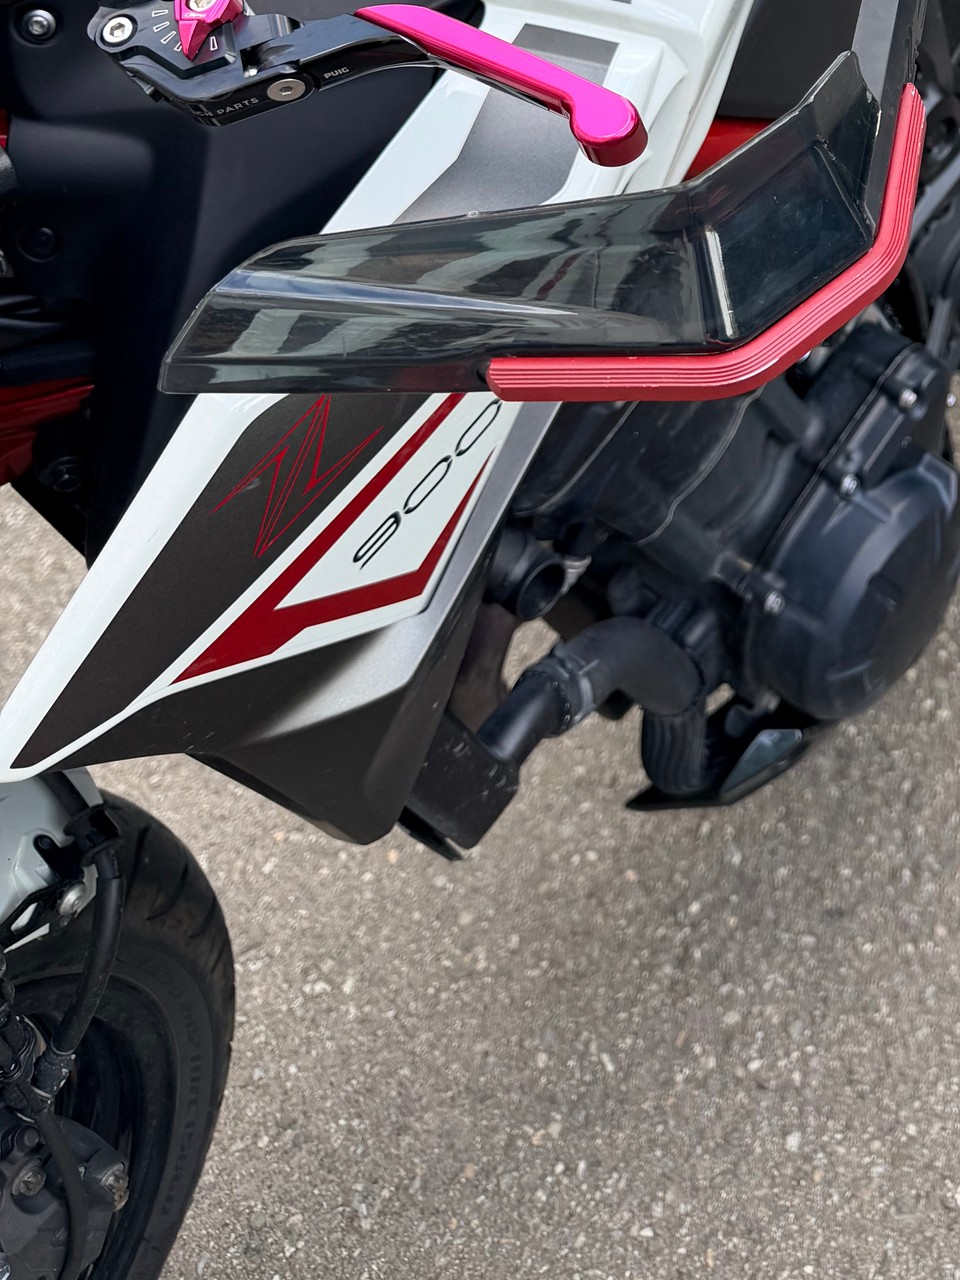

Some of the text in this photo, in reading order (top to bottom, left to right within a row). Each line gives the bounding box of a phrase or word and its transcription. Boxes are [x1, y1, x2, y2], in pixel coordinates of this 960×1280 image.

[323, 66, 350, 80] PUIG
[217, 96, 260, 116] PARTS
[352, 398, 503, 571] 900
